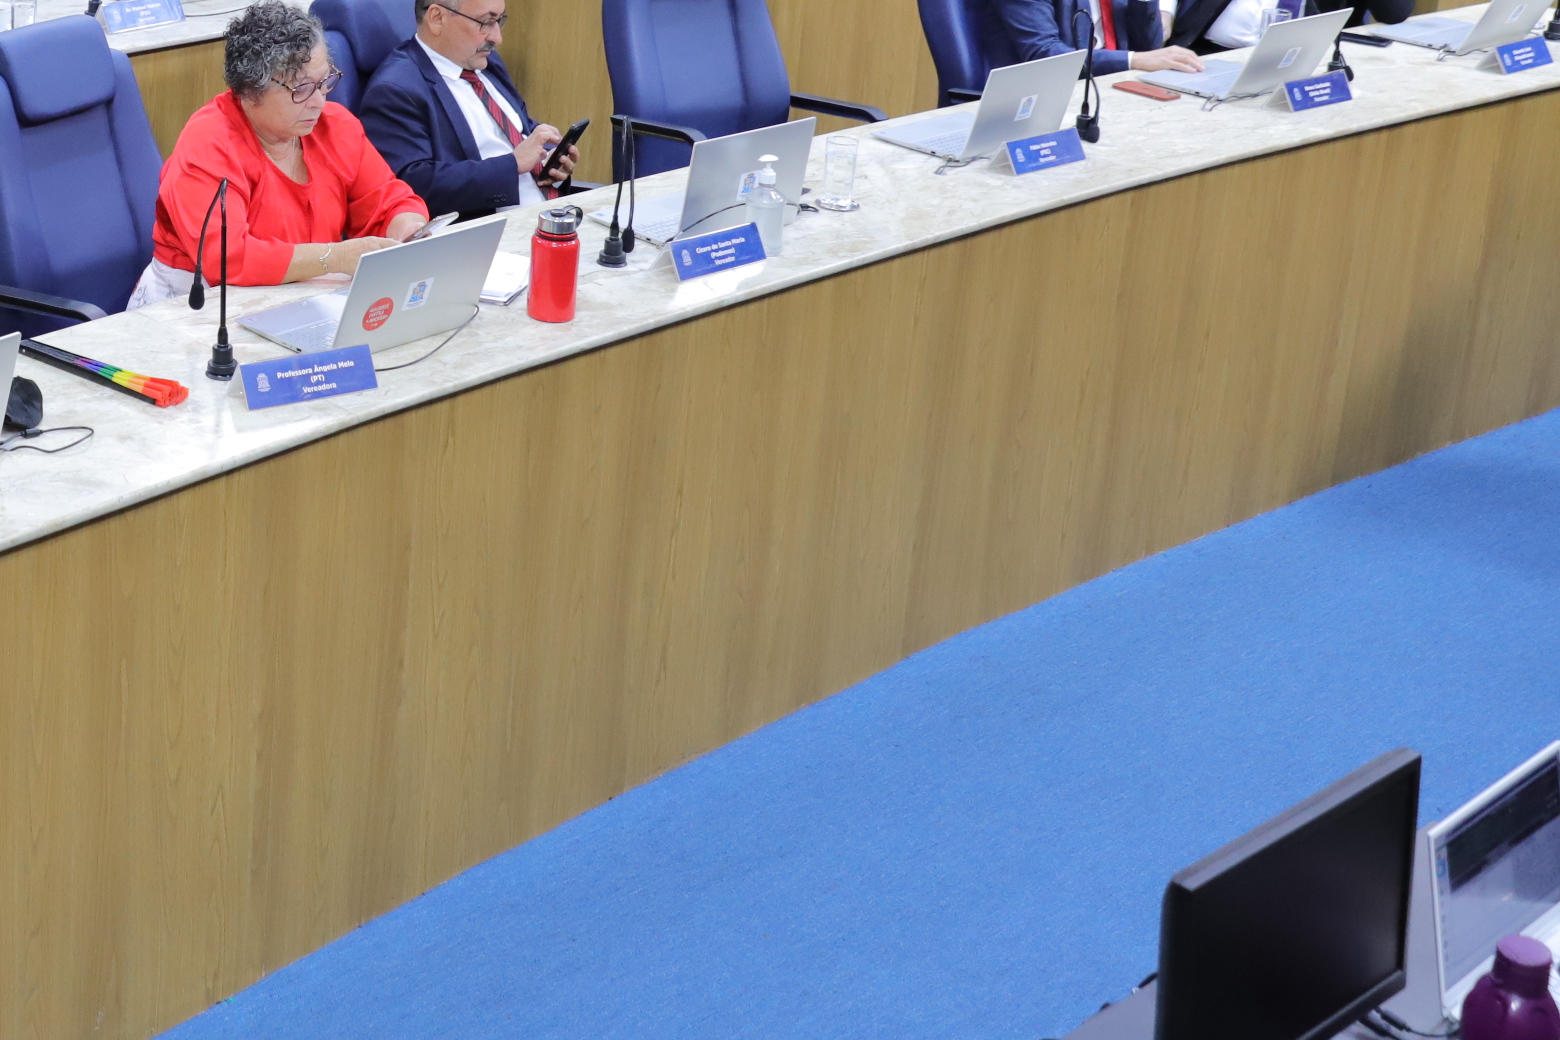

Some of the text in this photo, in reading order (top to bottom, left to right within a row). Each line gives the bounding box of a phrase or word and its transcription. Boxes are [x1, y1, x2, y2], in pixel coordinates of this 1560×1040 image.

[714, 256, 736, 265] Vereador
[276, 360, 354, 379] Professora Ângela Melo
[310, 374, 325, 383] (PT)
[302, 382, 337, 394] Vereadora
